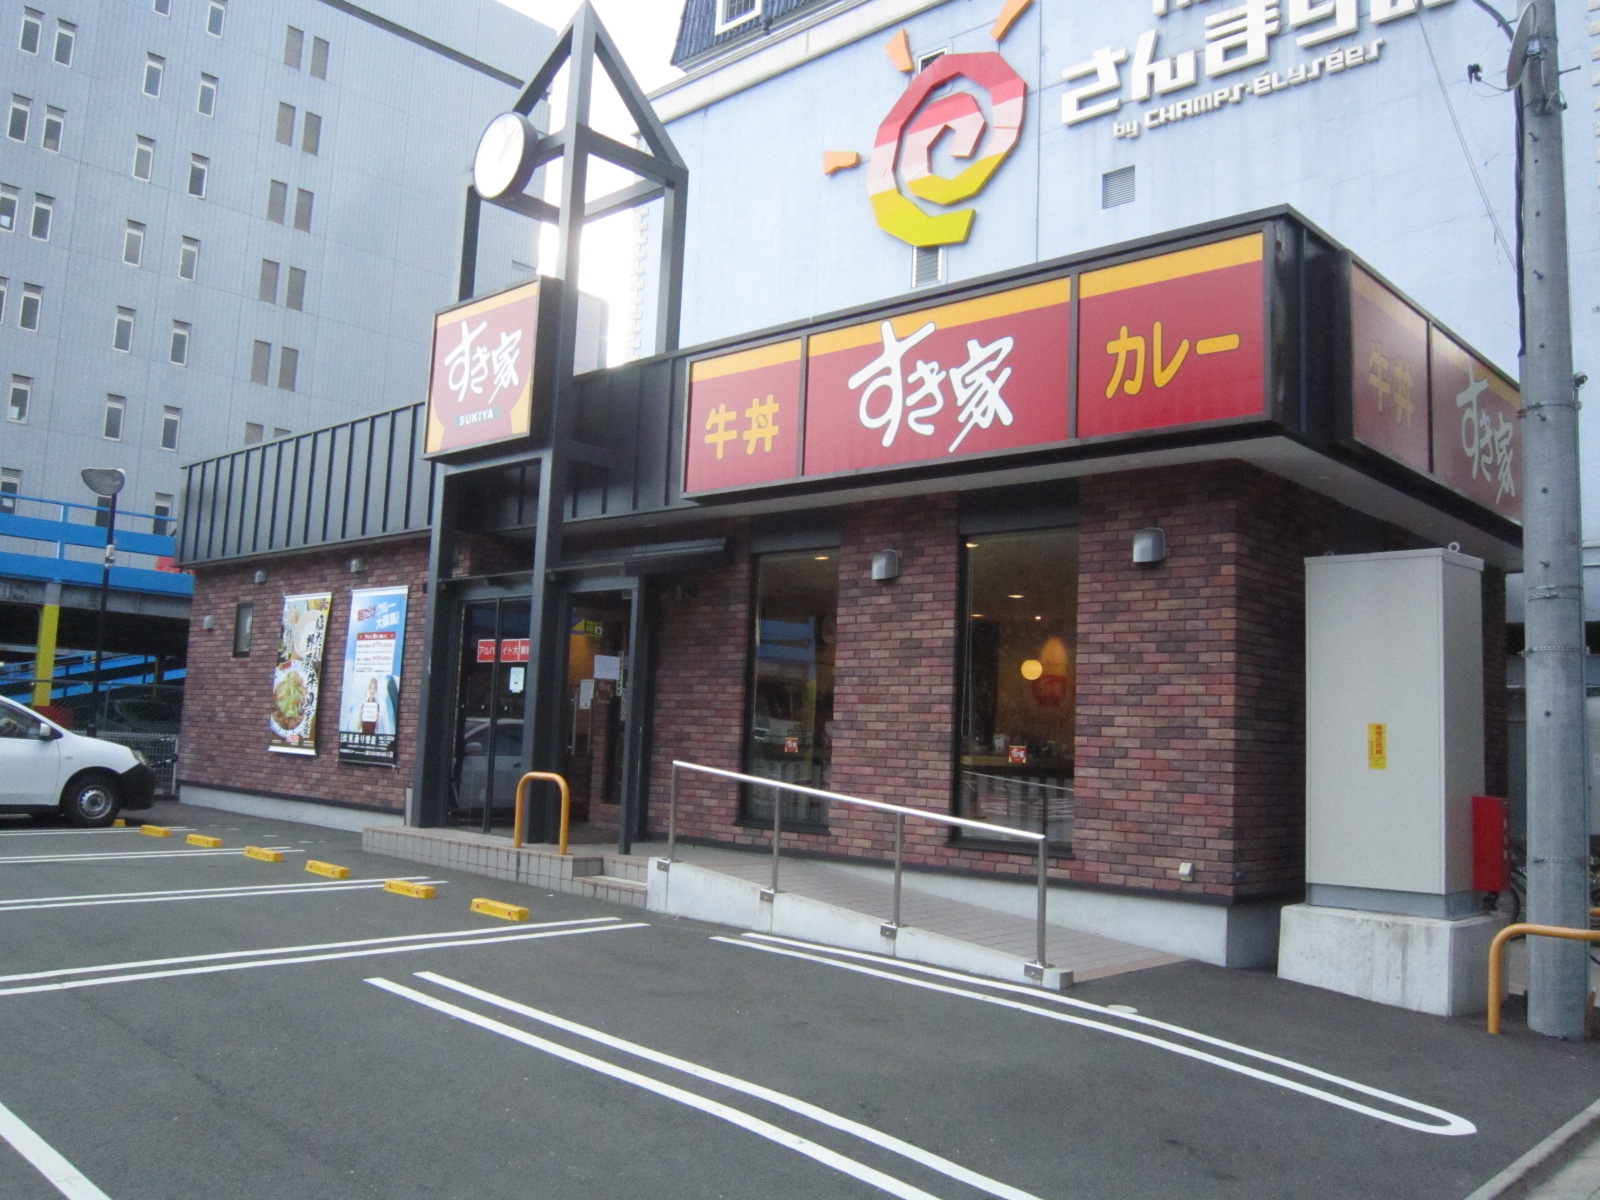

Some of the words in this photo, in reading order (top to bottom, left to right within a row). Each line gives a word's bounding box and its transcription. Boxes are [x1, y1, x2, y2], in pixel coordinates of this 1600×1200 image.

[1113, 119, 1140, 139] by
[444, 320, 523, 404] すき家
[848, 319, 1015, 454] すき家
[1105, 320, 1240, 400] カレー
[1368, 340, 1415, 430] 牛丼
[459, 409, 494, 426] SUKIYA
[704, 393, 780, 461] 牛丼
[1456, 360, 1516, 504] すき家
